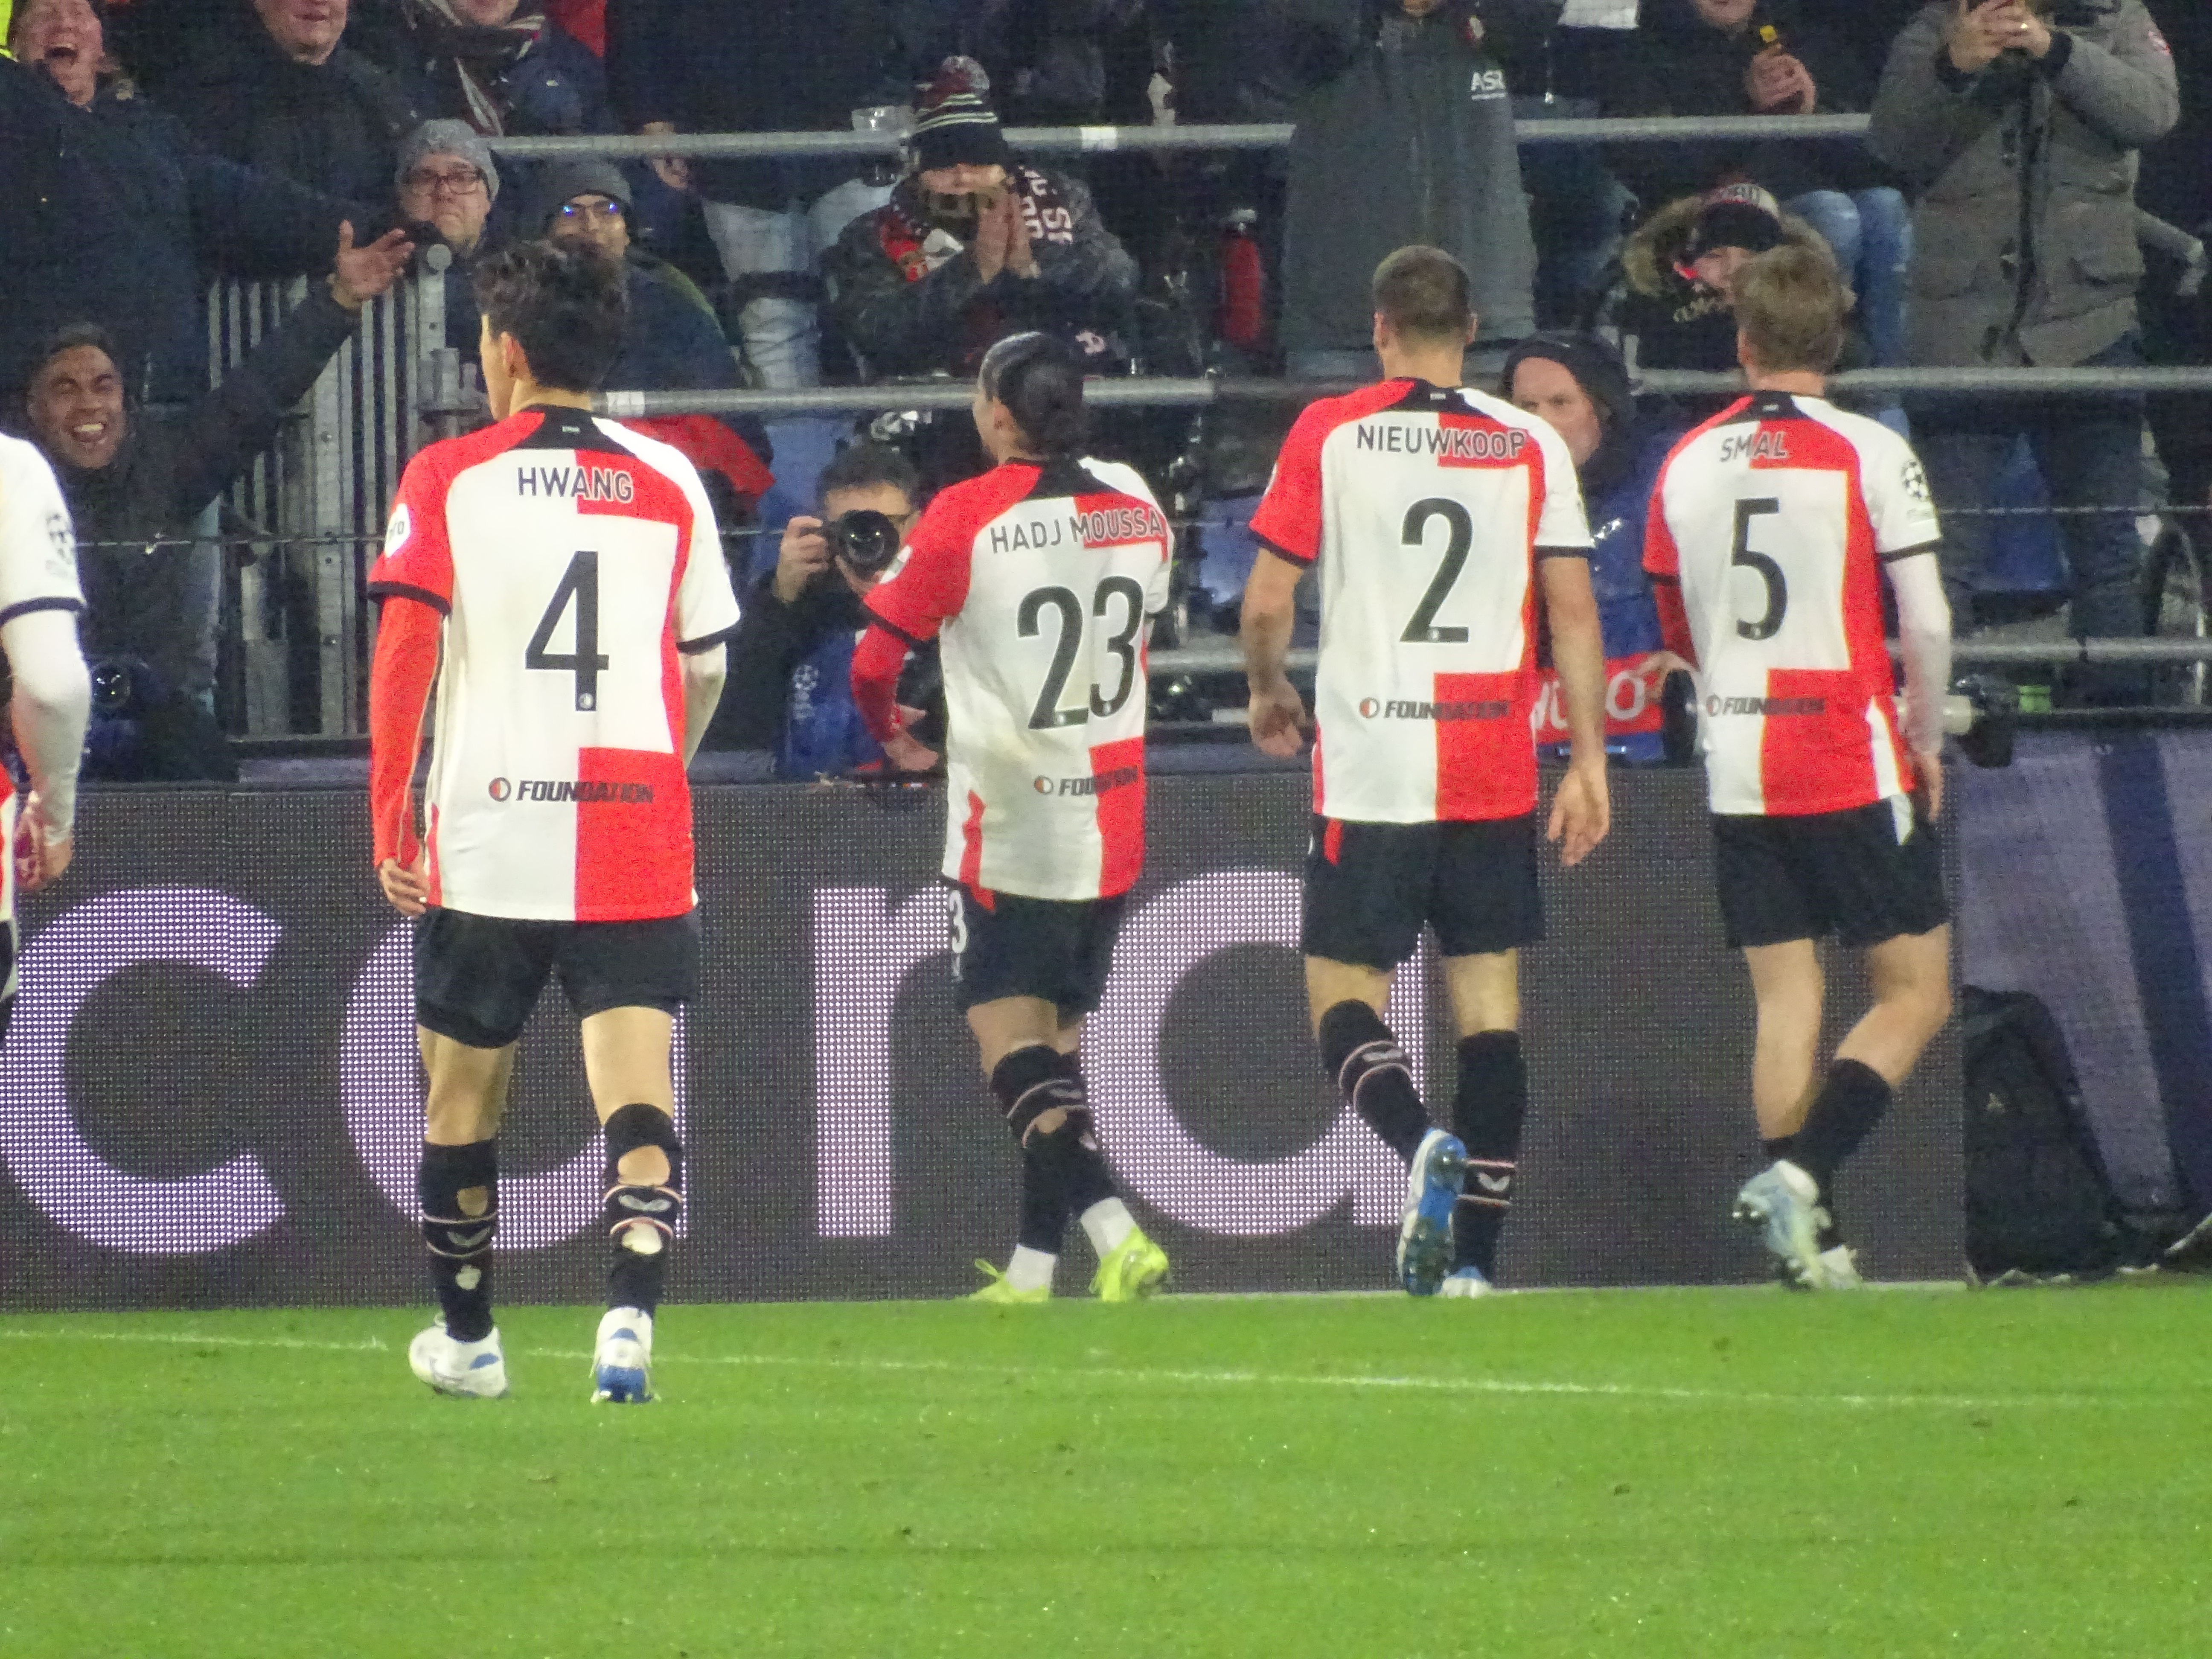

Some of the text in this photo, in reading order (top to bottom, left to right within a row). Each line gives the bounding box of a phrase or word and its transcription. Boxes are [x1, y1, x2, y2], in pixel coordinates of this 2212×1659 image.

[518, 466, 633, 502] HWANG
[1356, 424, 1525, 458] NIEUWKOOP
[1720, 432, 1787, 462] SMAL
[990, 509, 1164, 554] HADJ MOUSSA
[1399, 498, 1472, 642] 2
[1731, 498, 1787, 640] 5
[525, 550, 609, 711] 4
[1017, 576, 1143, 730] 23
